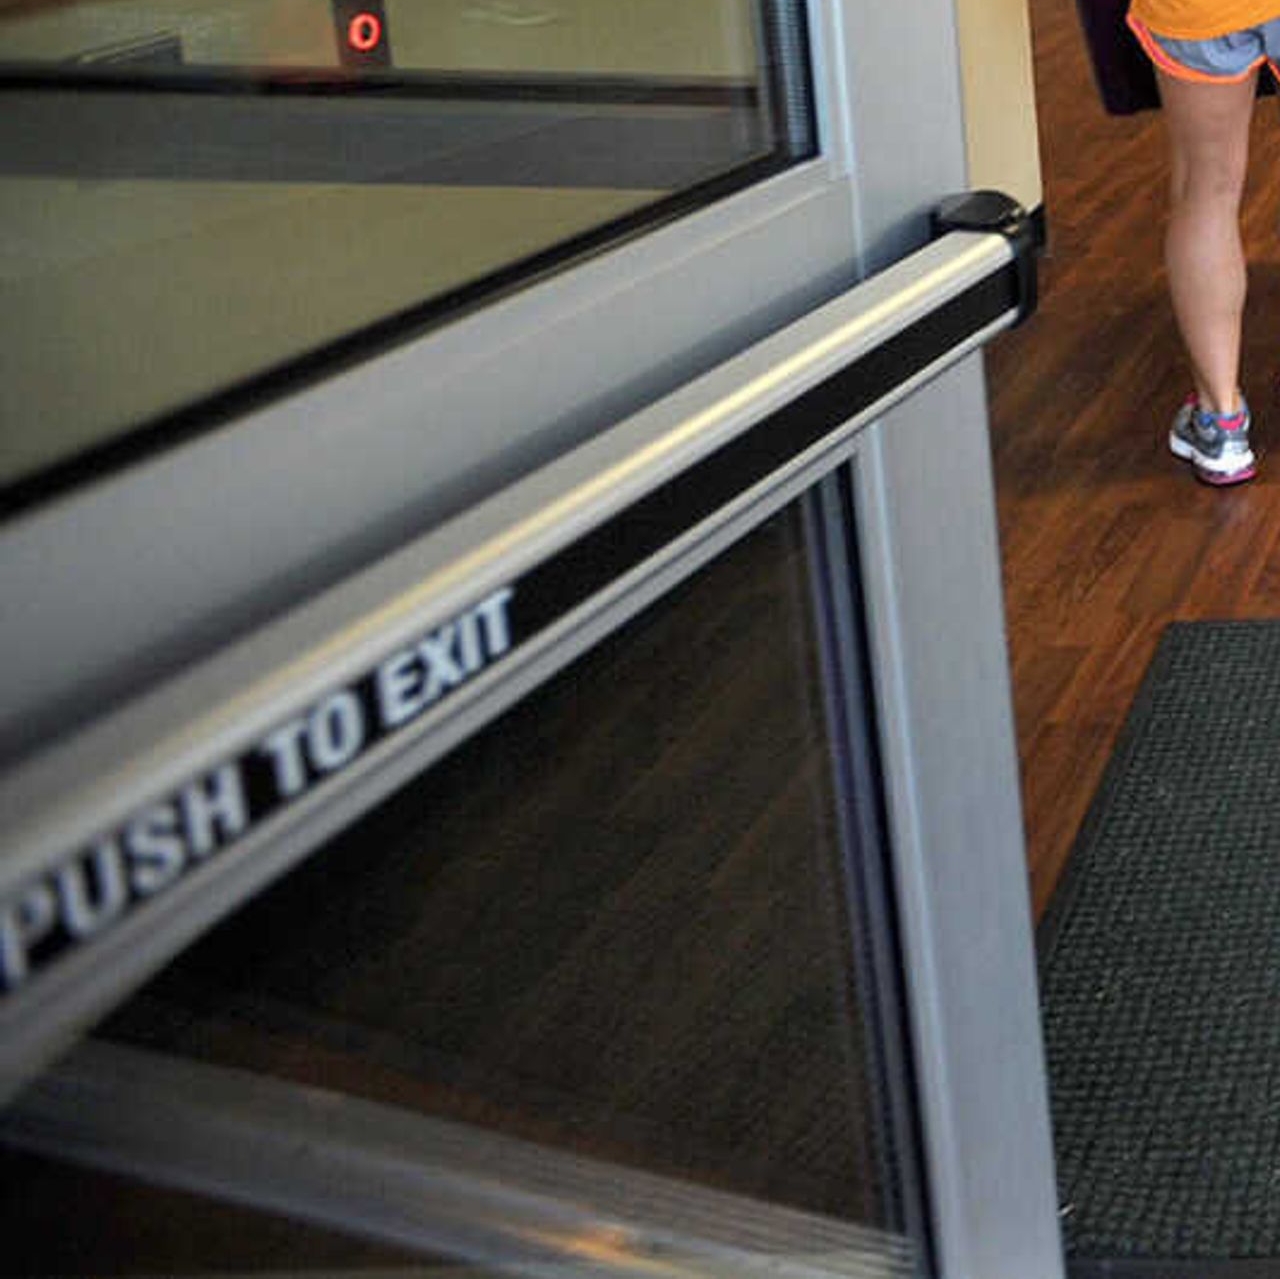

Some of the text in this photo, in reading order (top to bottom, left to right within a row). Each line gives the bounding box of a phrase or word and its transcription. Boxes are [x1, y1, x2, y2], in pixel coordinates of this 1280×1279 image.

[0, 586, 515, 989] PUSH TO EXIT
